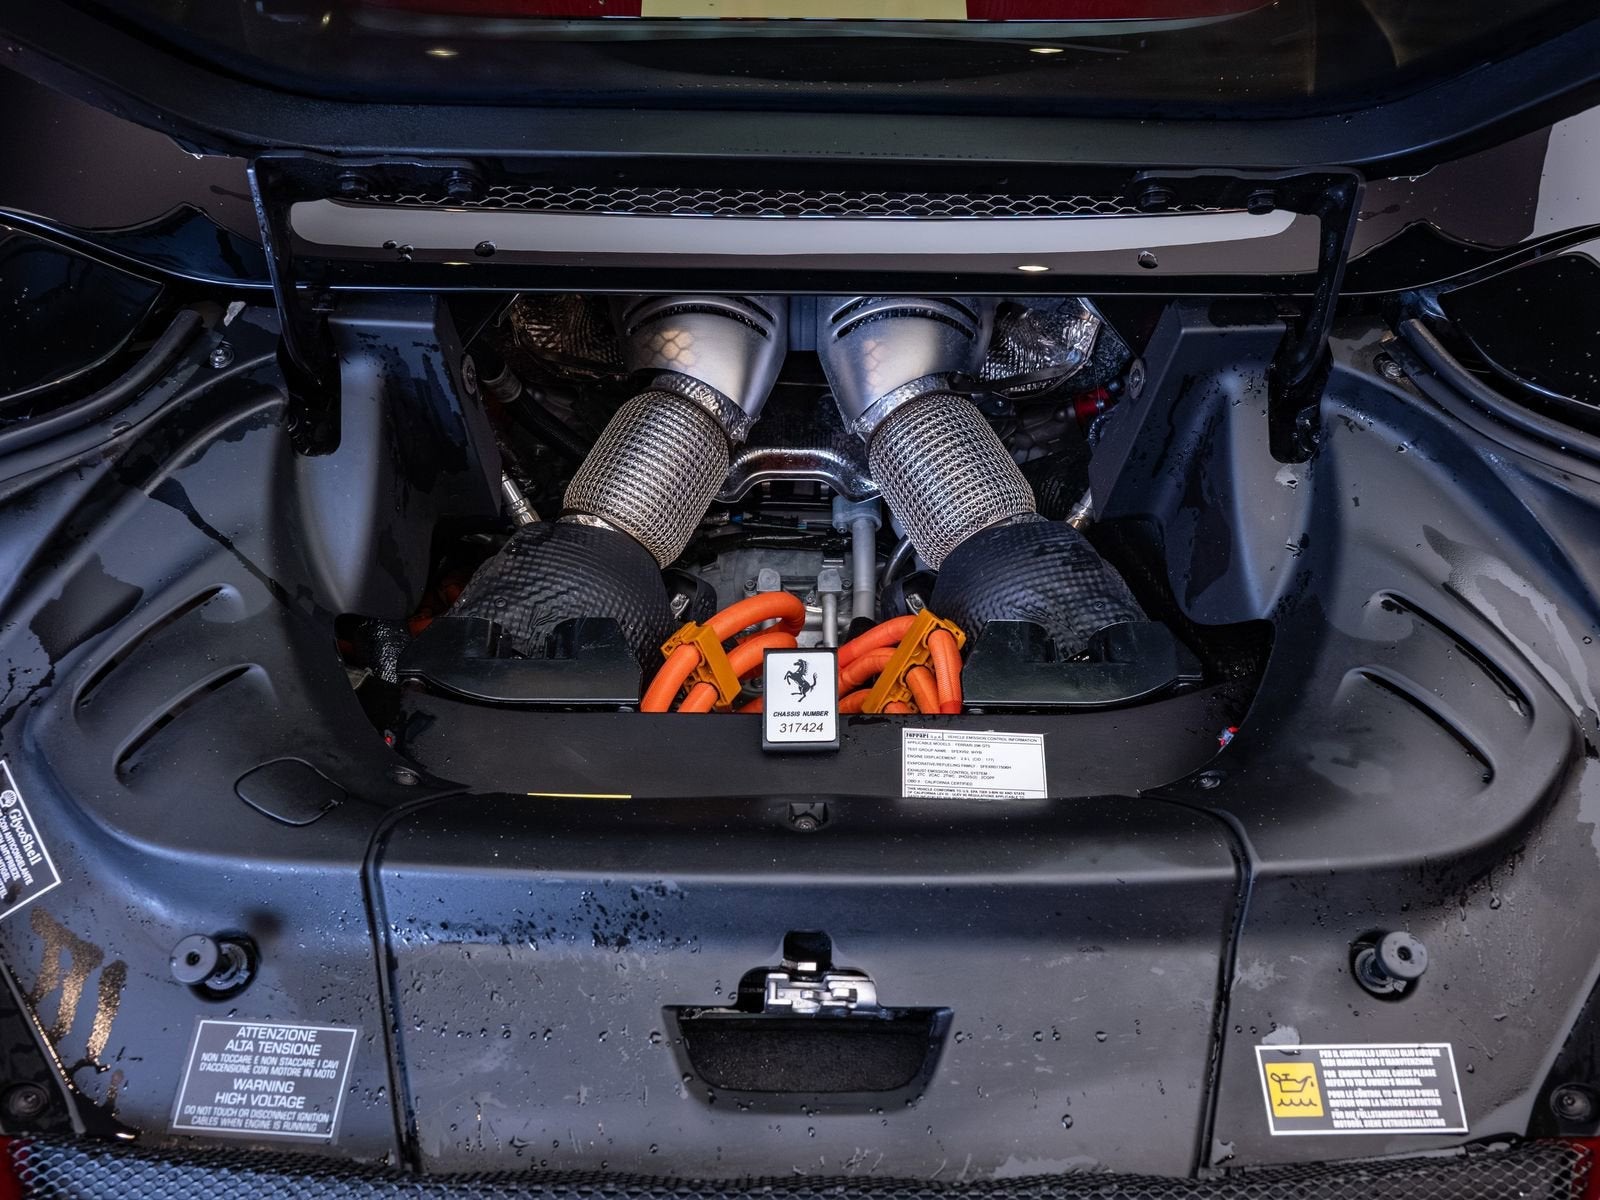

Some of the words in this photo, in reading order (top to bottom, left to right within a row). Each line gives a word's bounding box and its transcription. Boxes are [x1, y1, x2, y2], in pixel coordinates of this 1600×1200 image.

[779, 722, 824, 733] 317424
[10, 808, 42, 866] GlycoShell
[4, 831, 34, 886] ANTICONGELANTE
[236, 1026, 318, 1042] ATTENZIONE
[224, 1039, 254, 1052] ALTA
[258, 1041, 322, 1056] TENSIONE
[1339, 1050, 1376, 1058] CONTROLLO
[201, 1052, 220, 1062] NON
[220, 1053, 253, 1064] TOCCARE
[253, 1055, 260, 1065] E
[260, 1056, 279, 1066] NON
[278, 1056, 317, 1069] STACCARE
[198, 1062, 252, 1074] D'ACCENSIONE
[252, 1066, 270, 1076] CON
[270, 1066, 303, 1078] MOTORE
[302, 1068, 313, 1078] IN
[312, 1069, 337, 1080] MOTO
[1412, 1069, 1437, 1077] PLEASE
[233, 1078, 296, 1094] WARNING
[214, 1092, 248, 1106] HIGH
[250, 1094, 306, 1109] VOLTAGE
[184, 1104, 196, 1115] DO
[196, 1106, 212, 1116] NOT
[212, 1106, 239, 1118] TOUCH
[238, 1108, 250, 1118] OR
[250, 1109, 297, 1122] DISCONNECT
[296, 1112, 330, 1123] IGNITION
[191, 1115, 220, 1126] CABLES
[220, 1117, 244, 1128] WHEN
[244, 1118, 272, 1130] ENGINE
[272, 1120, 282, 1130] IS
[282, 1121, 318, 1132] RUNNING
